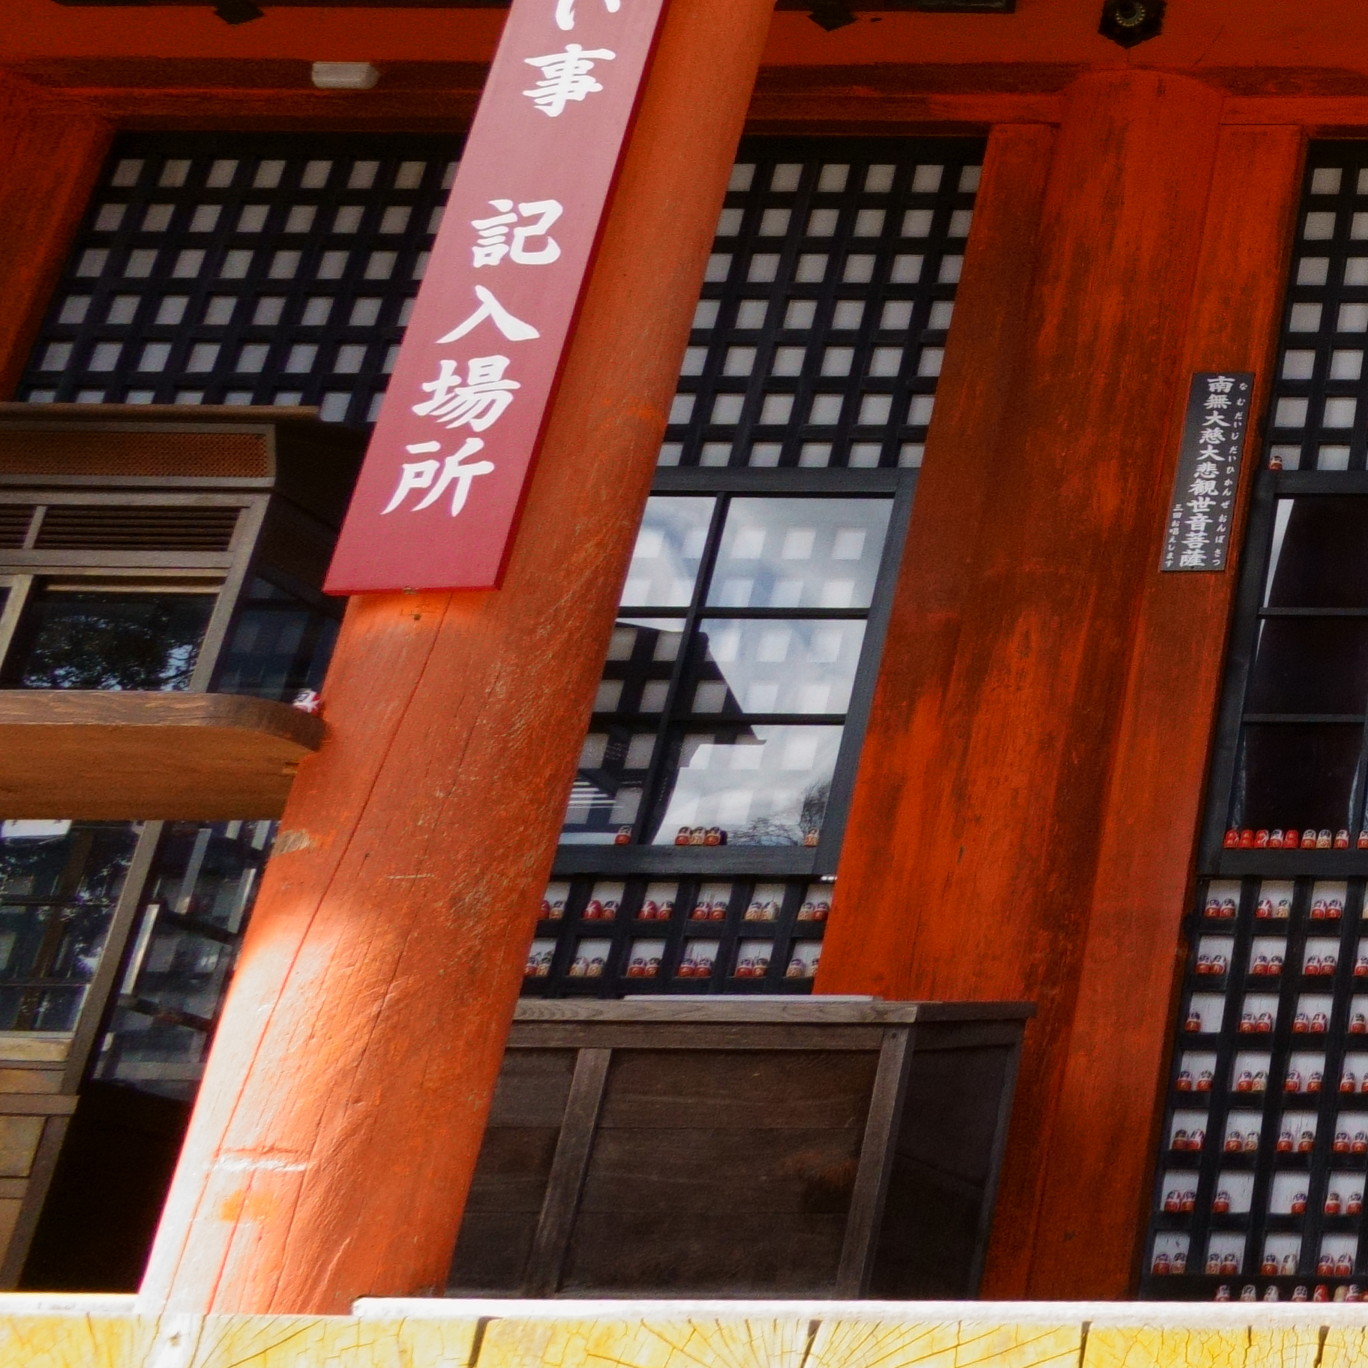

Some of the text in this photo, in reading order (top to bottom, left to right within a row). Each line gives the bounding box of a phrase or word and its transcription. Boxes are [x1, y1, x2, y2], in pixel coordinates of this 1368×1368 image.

[380, 198, 564, 517] 記入場所
[1179, 374, 1236, 568] 南無大慈大悲観世音菩薩
